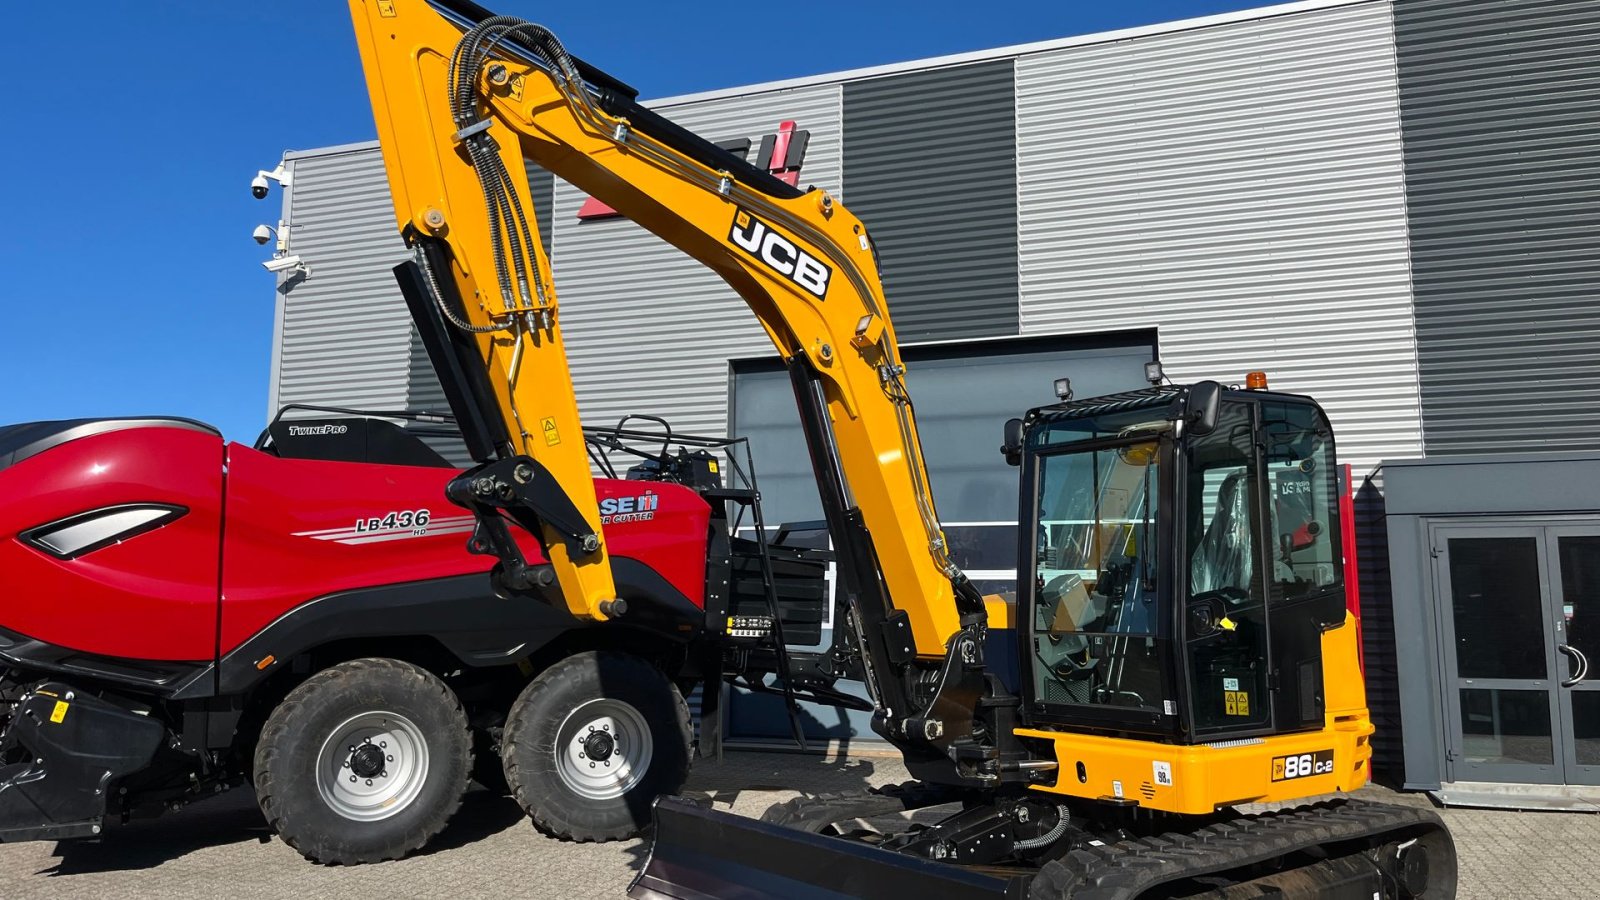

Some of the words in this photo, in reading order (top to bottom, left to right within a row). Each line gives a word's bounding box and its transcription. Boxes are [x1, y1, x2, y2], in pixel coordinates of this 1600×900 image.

[732, 221, 829, 296] JCB
[600, 497, 635, 515] SE
[355, 509, 431, 533] LB436
[612, 511, 654, 524] CUTTER
[413, 528, 427, 537] HD
[1284, 754, 1312, 778] 86
